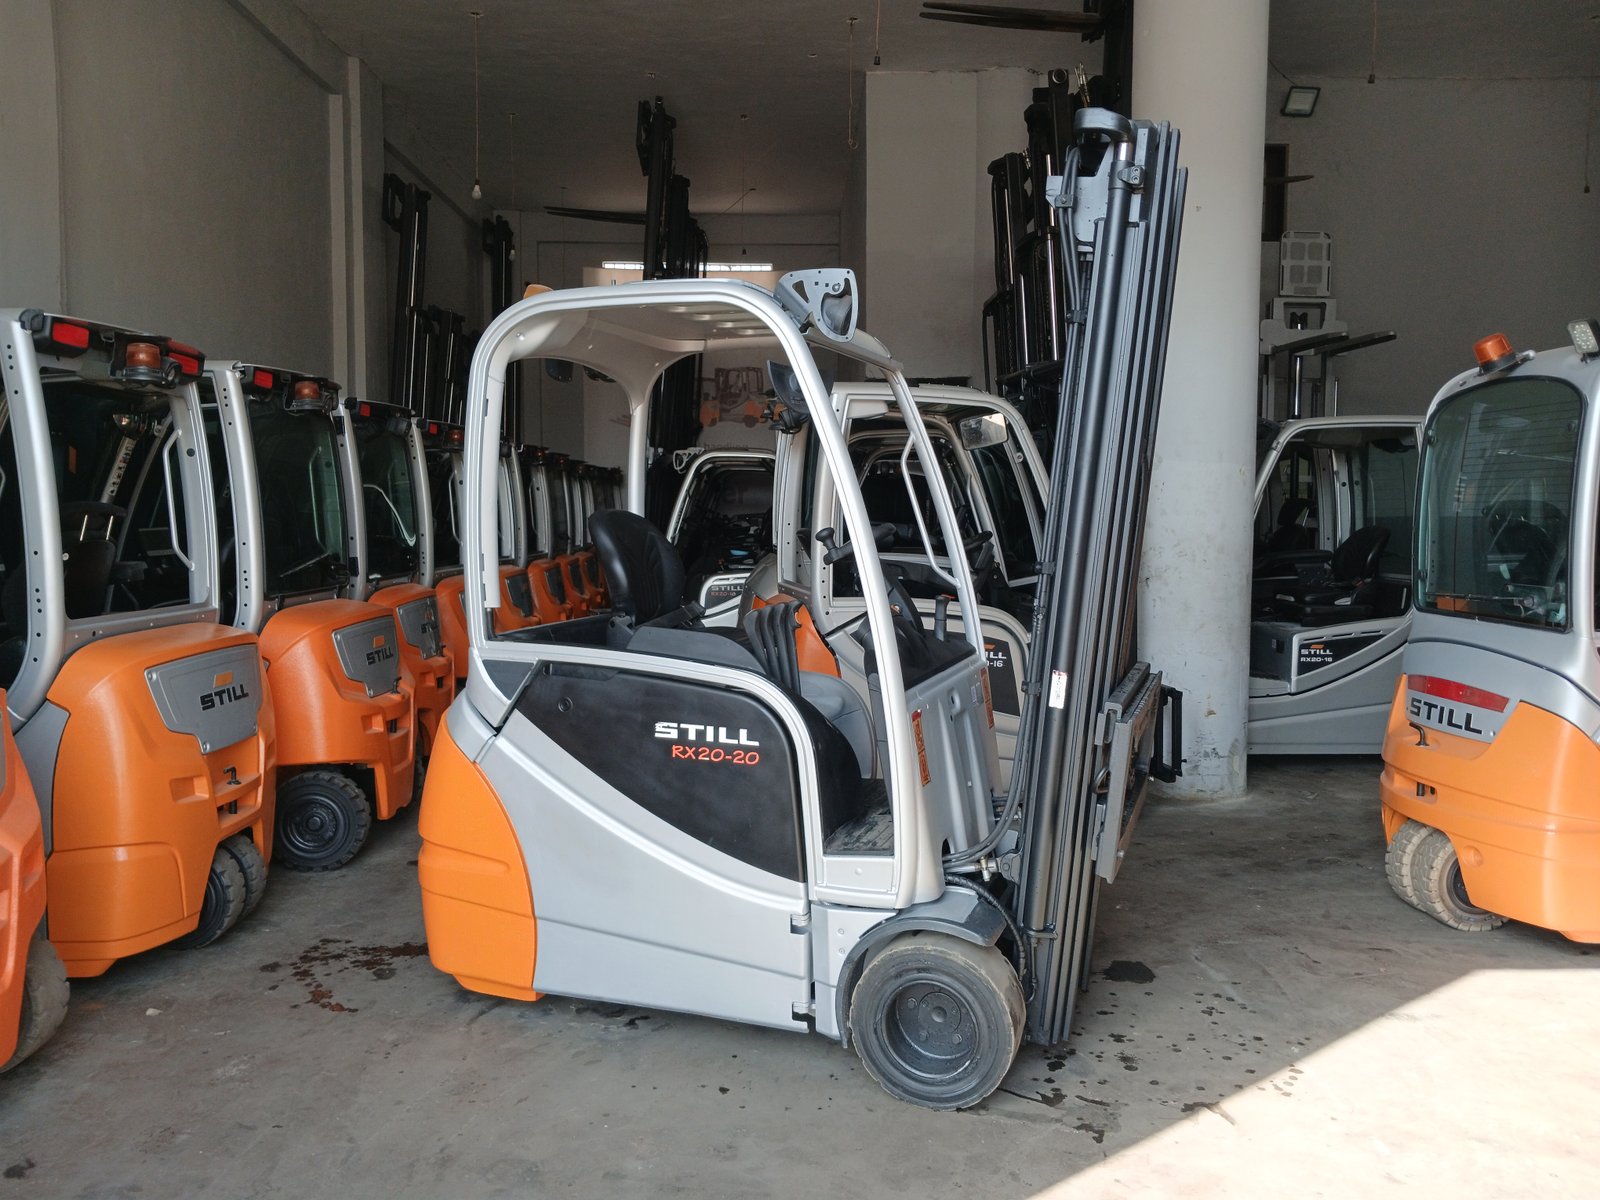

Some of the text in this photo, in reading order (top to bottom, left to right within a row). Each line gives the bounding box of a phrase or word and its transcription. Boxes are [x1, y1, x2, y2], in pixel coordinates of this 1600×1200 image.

[366, 647, 393, 665] STILL
[985, 651, 1007, 659] ILL
[200, 684, 249, 711] STILL
[1409, 697, 1482, 735] STILL
[654, 721, 760, 746] STILL
[671, 745, 760, 765] RX20-20
